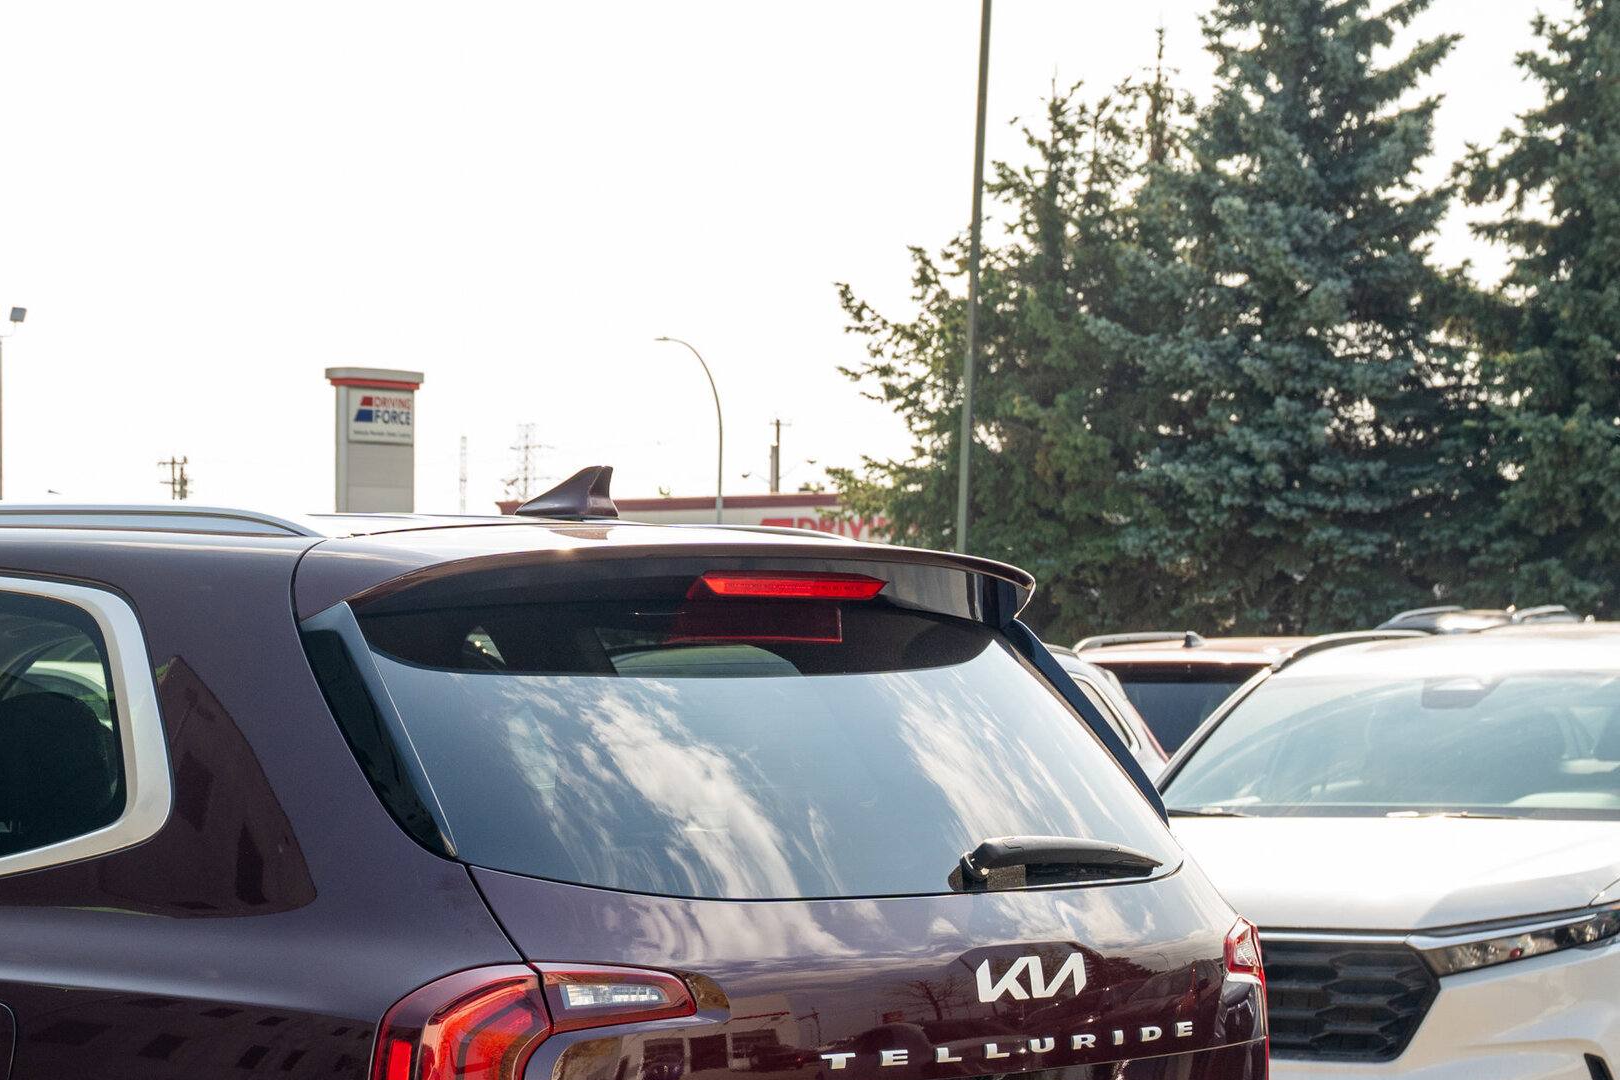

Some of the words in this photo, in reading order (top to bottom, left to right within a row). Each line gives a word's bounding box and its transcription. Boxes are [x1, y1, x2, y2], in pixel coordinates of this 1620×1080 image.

[374, 396, 412, 409] DRIVING
[374, 410, 411, 425] FORCE
[975, 953, 1086, 1002] KIA
[820, 1021, 1193, 1069] TELLURIDE
